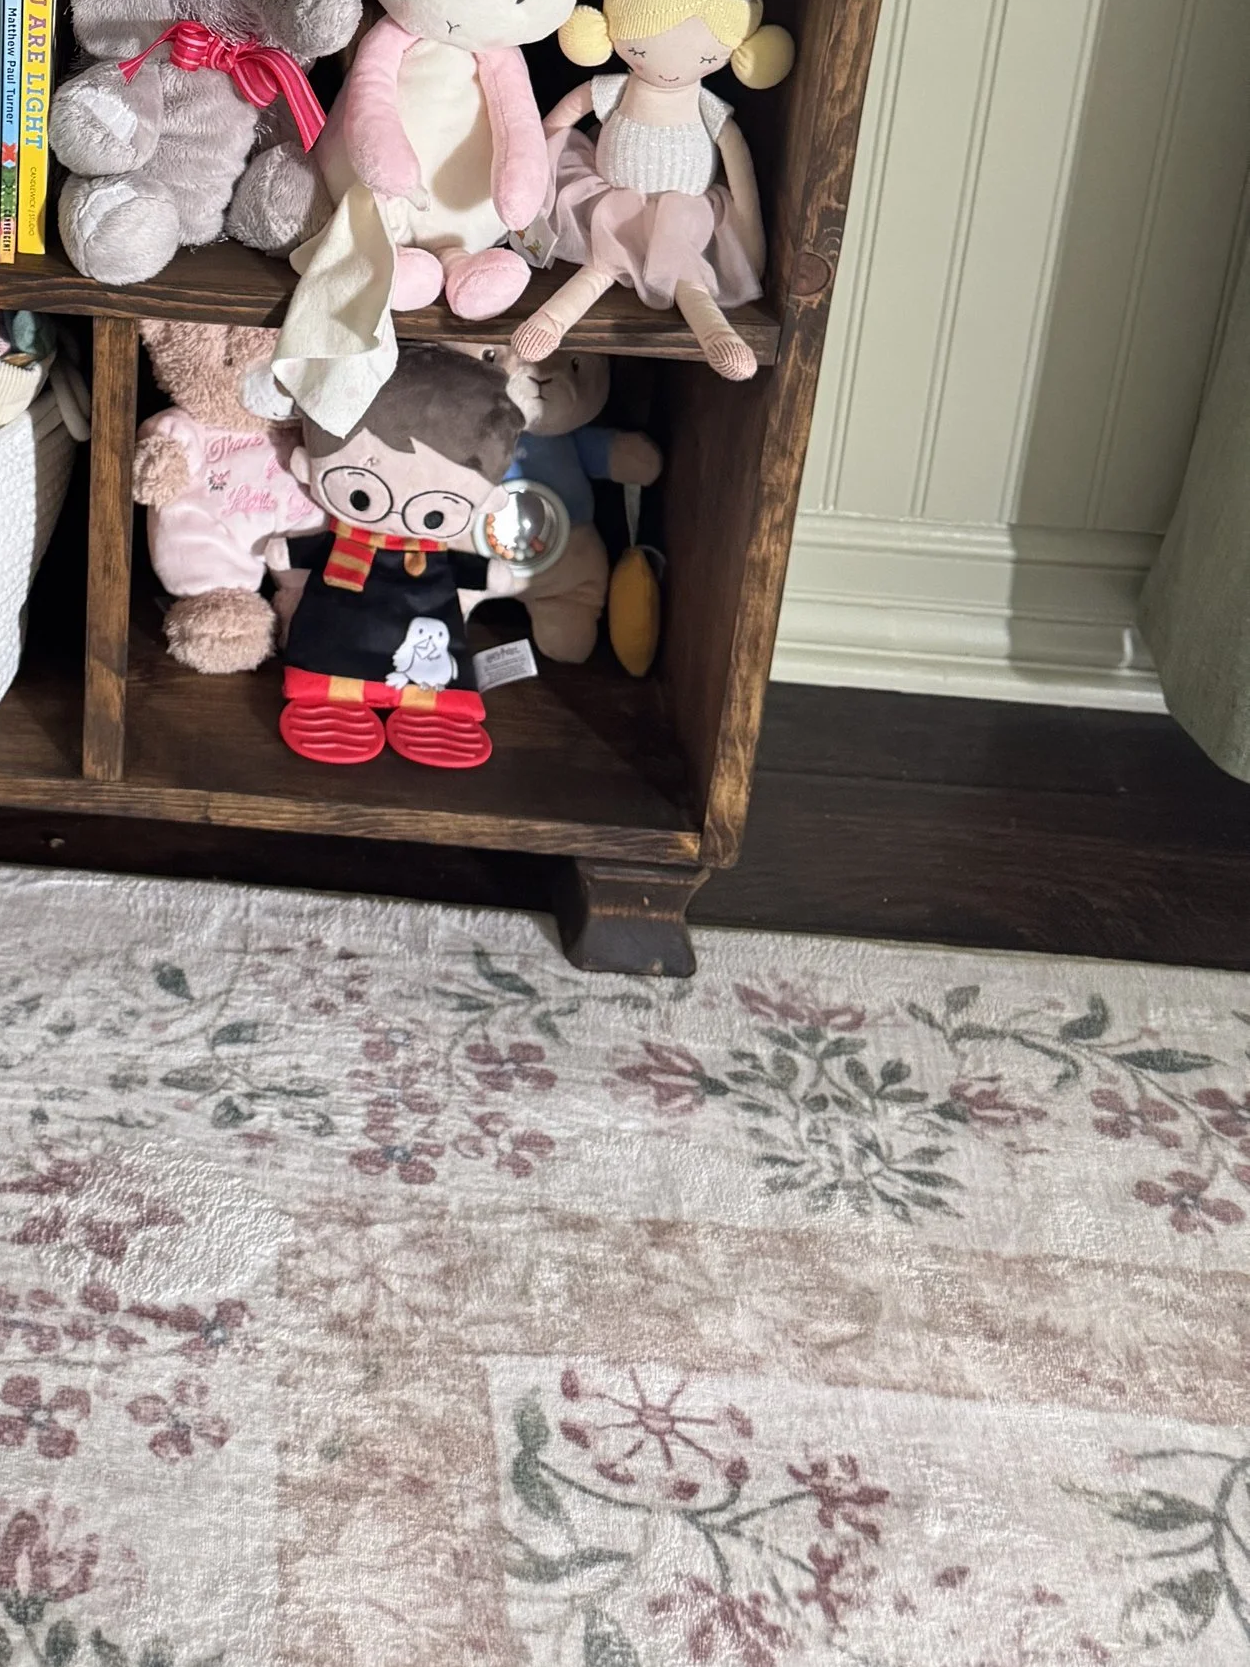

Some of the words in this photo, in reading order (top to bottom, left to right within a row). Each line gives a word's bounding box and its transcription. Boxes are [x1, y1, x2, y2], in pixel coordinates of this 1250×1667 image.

[7, 8, 17, 58] Matthew
[28, 14, 47, 64] ARE
[6, 60, 16, 84] Paul
[6, 88, 16, 124] Turner
[26, 72, 44, 149] LIGHT
